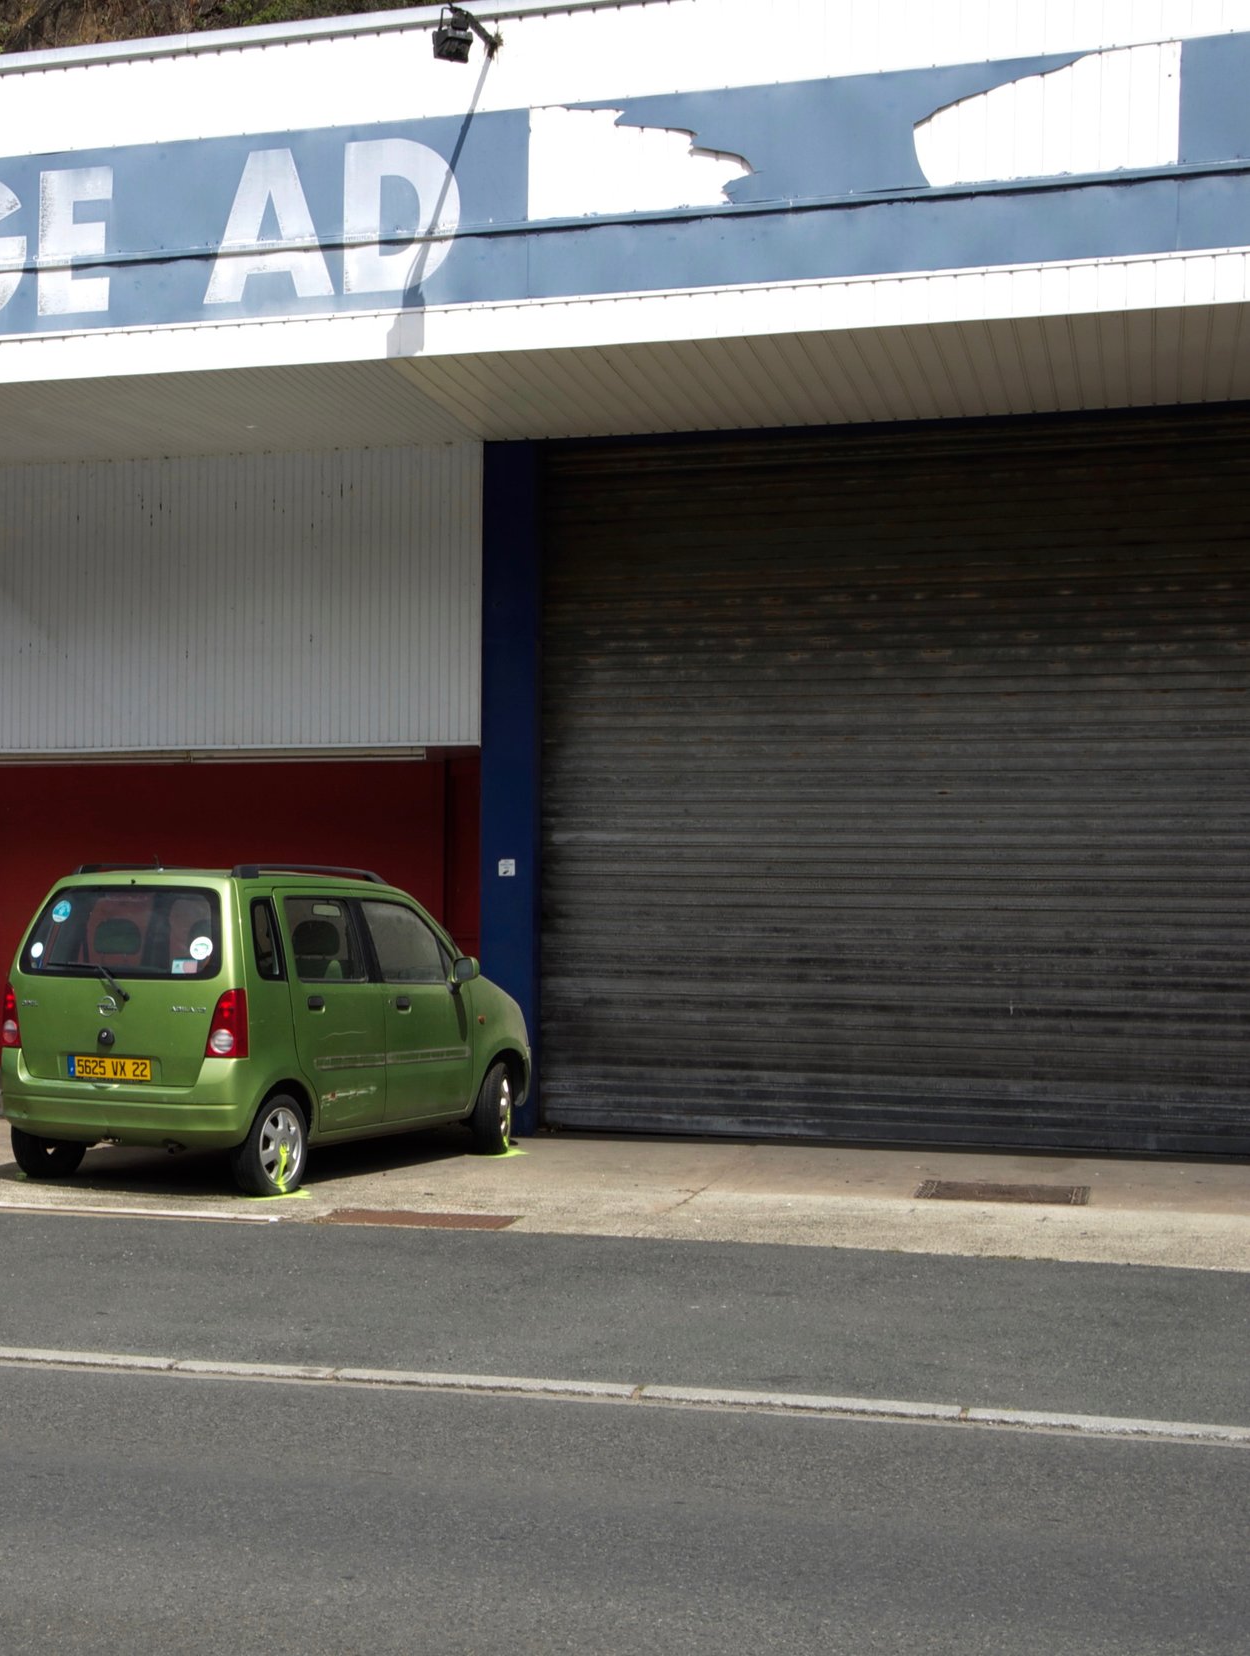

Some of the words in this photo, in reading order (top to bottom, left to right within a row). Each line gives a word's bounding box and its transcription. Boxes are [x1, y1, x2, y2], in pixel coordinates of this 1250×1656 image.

[203, 138, 461, 304] AD
[77, 1059, 106, 1075] 5625
[111, 1061, 126, 1077] VX
[132, 1062, 148, 1077] 22
